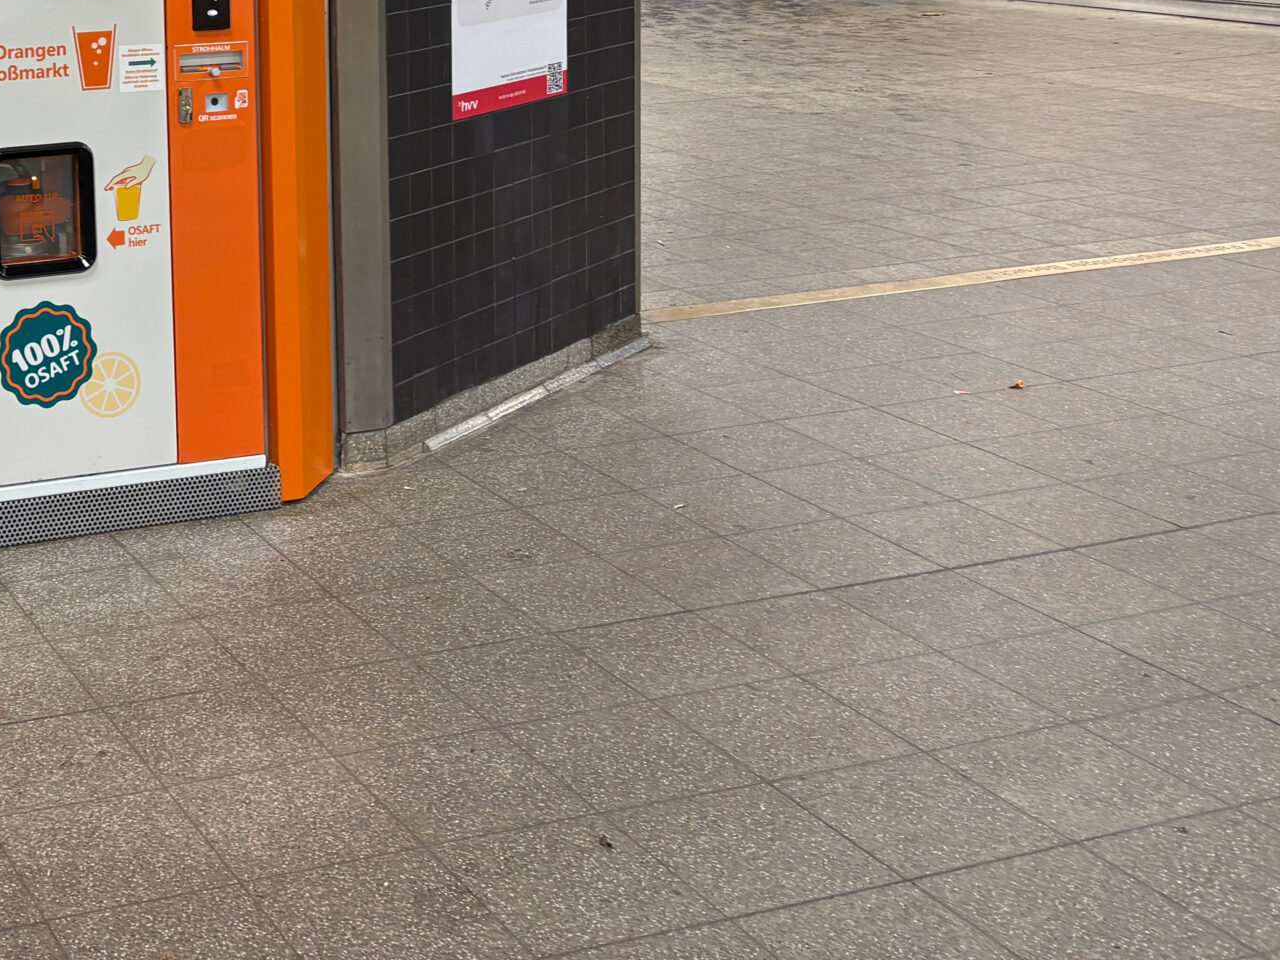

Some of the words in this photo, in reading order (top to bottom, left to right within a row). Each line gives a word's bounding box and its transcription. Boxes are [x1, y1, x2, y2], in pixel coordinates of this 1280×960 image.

[192, 44, 231, 53] STROHHALM
[127, 223, 161, 236] OSAFT
[128, 237, 148, 248] hier
[11, 324, 79, 372] 100%
[24, 349, 81, 389] OSAFT
